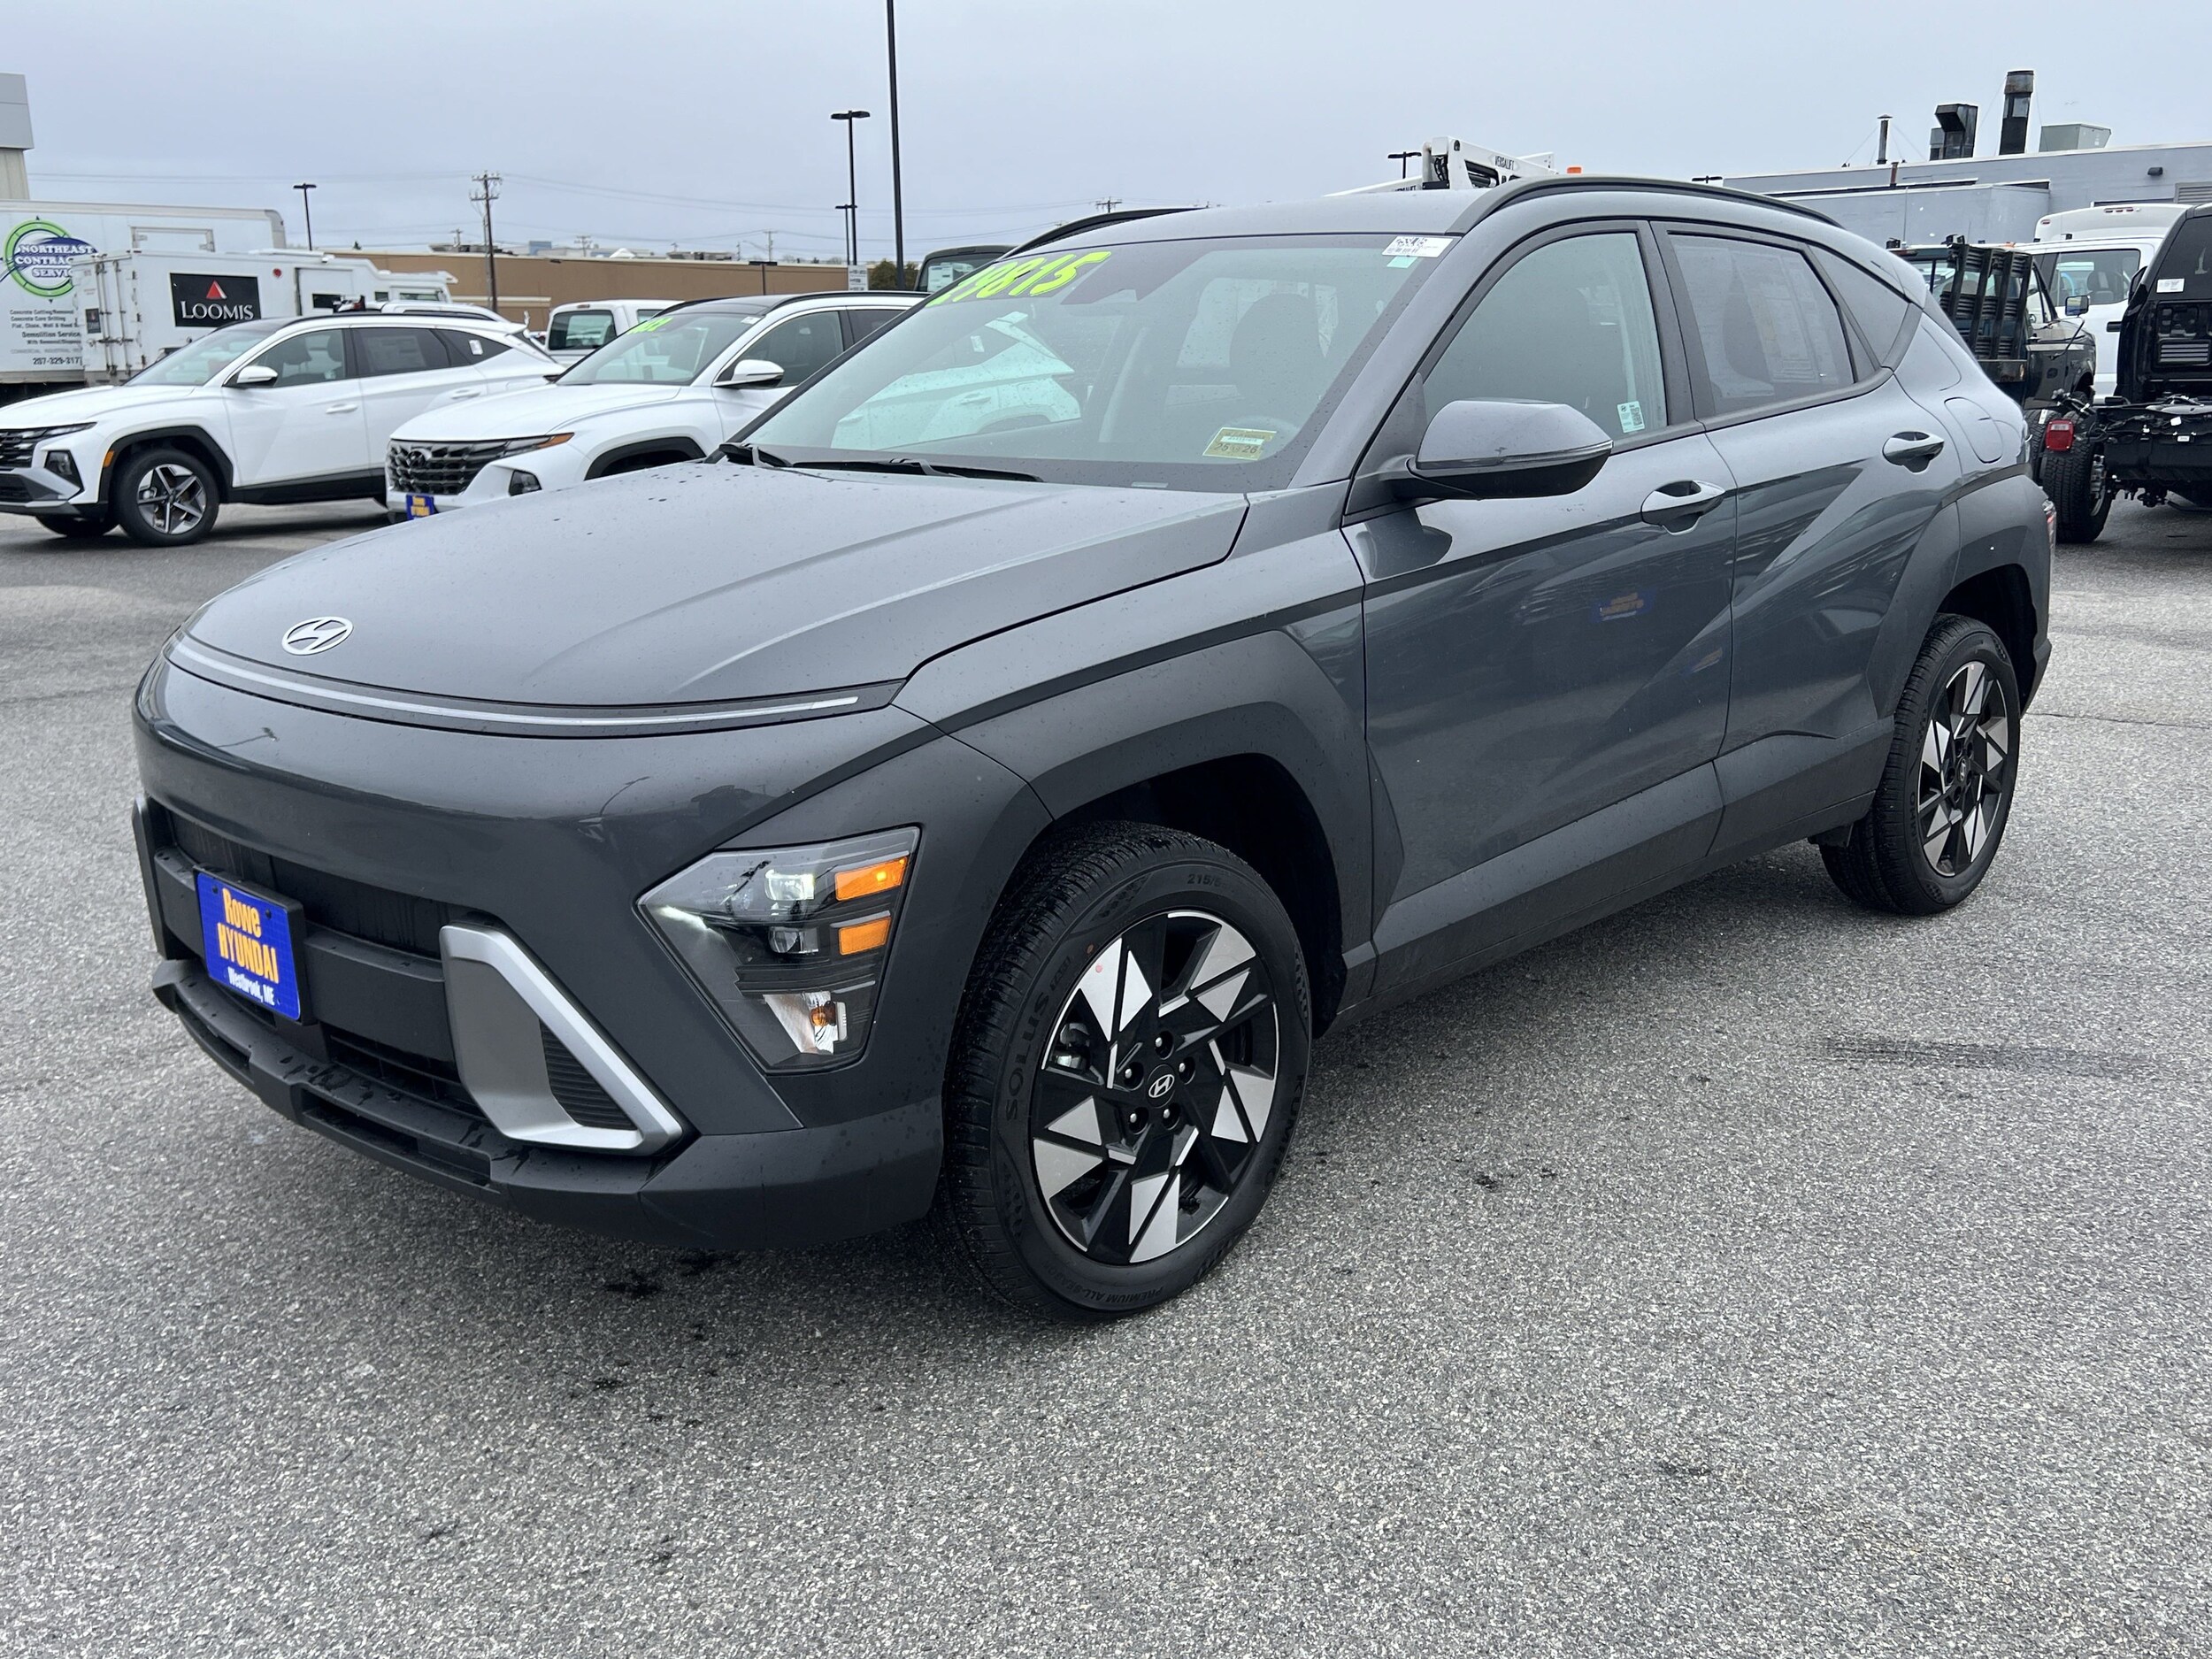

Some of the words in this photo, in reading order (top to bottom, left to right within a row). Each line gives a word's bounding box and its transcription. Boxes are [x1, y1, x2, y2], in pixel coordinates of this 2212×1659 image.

[1494, 155, 1514, 171] VERSALIFT
[19, 244, 93, 254] NORTHEAST
[180, 300, 254, 320] LOOMIS
[1214, 442, 1230, 452] 25
[1242, 444, 1258, 454] 26
[222, 887, 262, 938] Rowe
[218, 922, 280, 984] HYUNDAI
[1005, 991, 1050, 1122] SOLUS
[1105, 1286, 1164, 1304] PREMIUM
